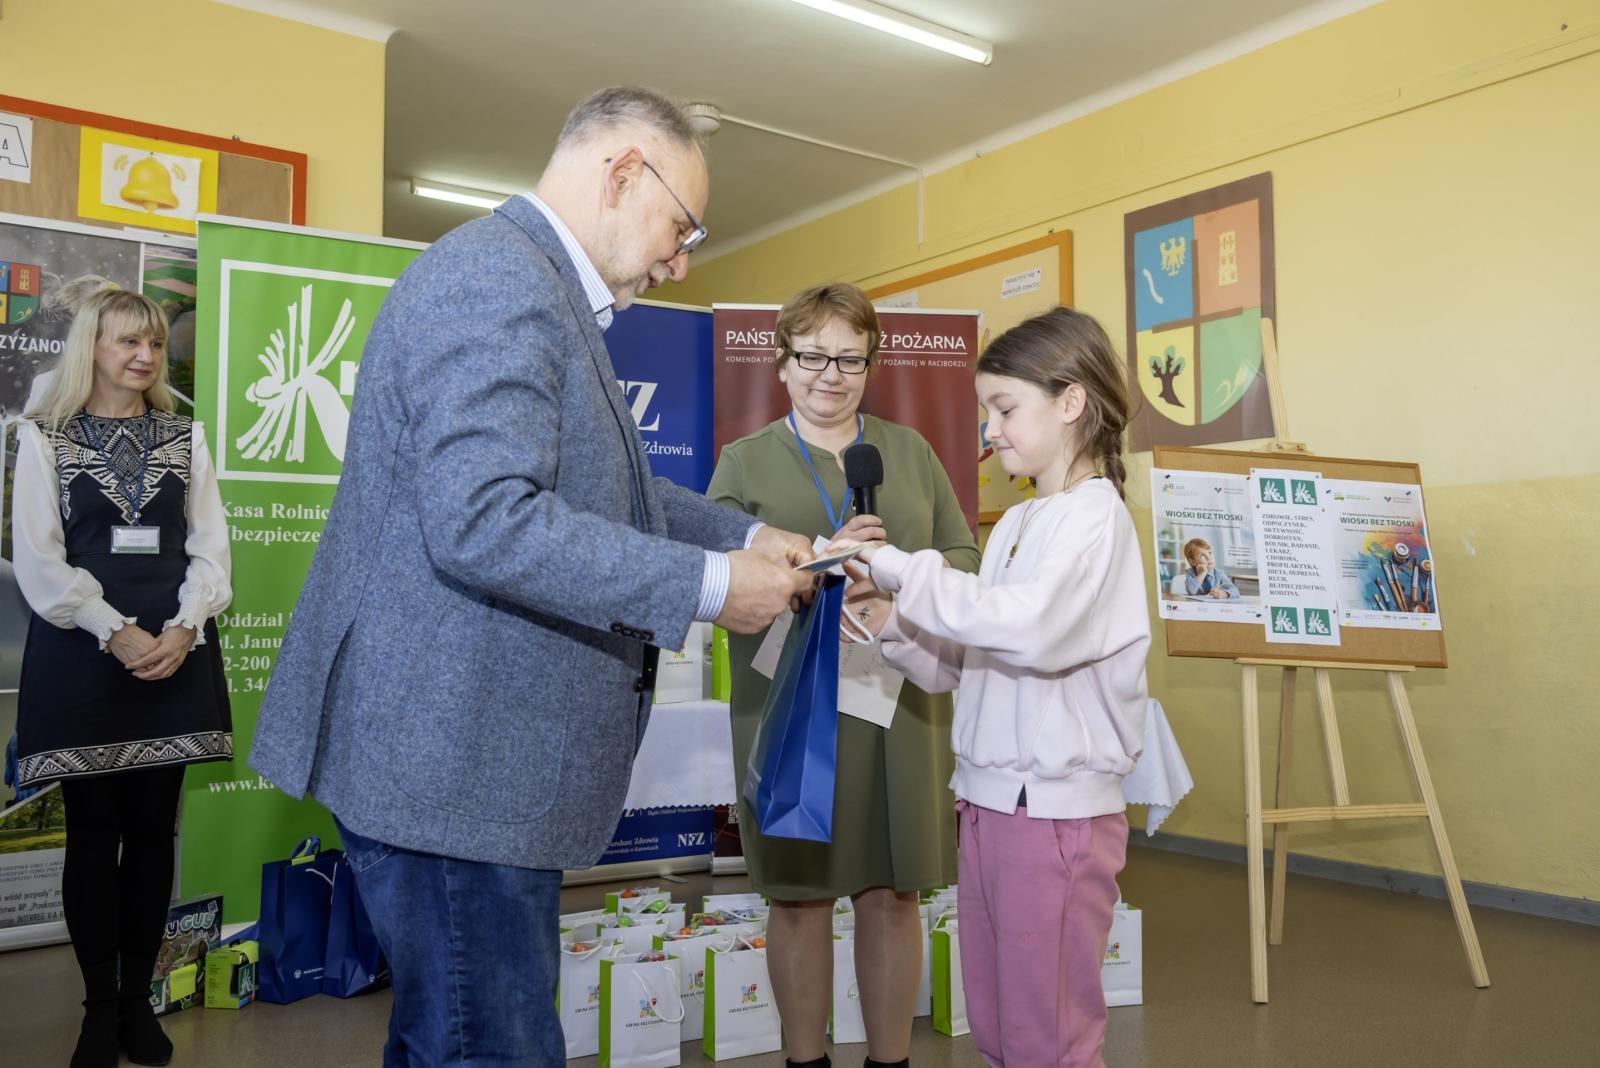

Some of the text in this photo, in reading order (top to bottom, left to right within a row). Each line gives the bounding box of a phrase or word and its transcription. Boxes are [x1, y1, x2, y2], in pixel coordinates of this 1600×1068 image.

[0, 332, 67, 354] ZYŻANO
[892, 331, 967, 350] POŻARNA
[883, 359, 918, 367] POŻARNEJ
[642, 441, 693, 456] Zdrowia
[222, 501, 264, 518] Kasa
[1165, 510, 1243, 522] WIOSKI BEZ TROSKI
[1340, 517, 1415, 528] WIOSKI BEZ TROSKI
[227, 525, 321, 546] bezpiecze
[215, 612, 283, 628] Oddział
[677, 832, 706, 848] NFZ
